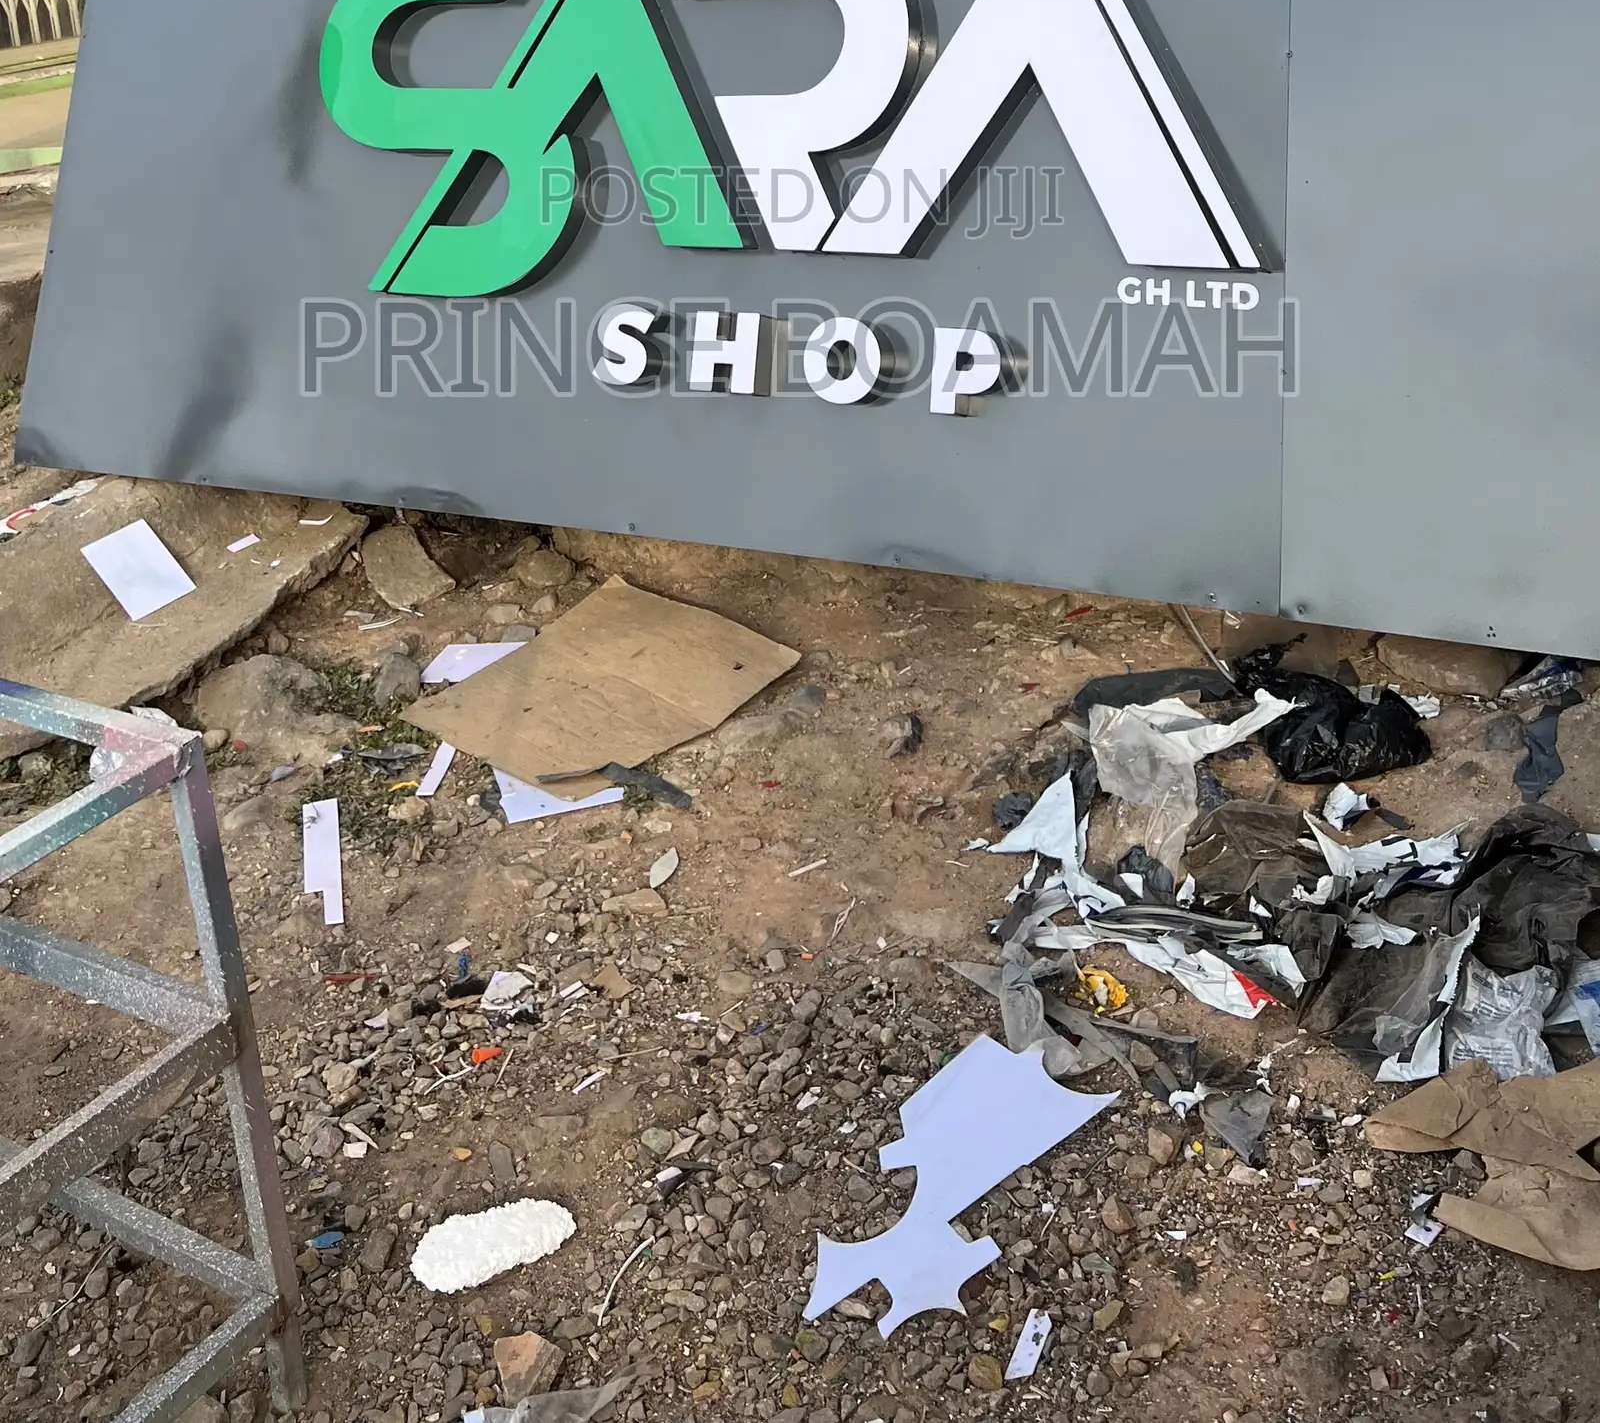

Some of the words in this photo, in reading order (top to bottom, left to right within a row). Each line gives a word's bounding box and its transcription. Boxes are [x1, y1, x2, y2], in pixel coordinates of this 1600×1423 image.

[1117, 276, 1171, 306] GH
[1185, 280, 1260, 311] LTD
[592, 304, 1001, 414] SHOP
